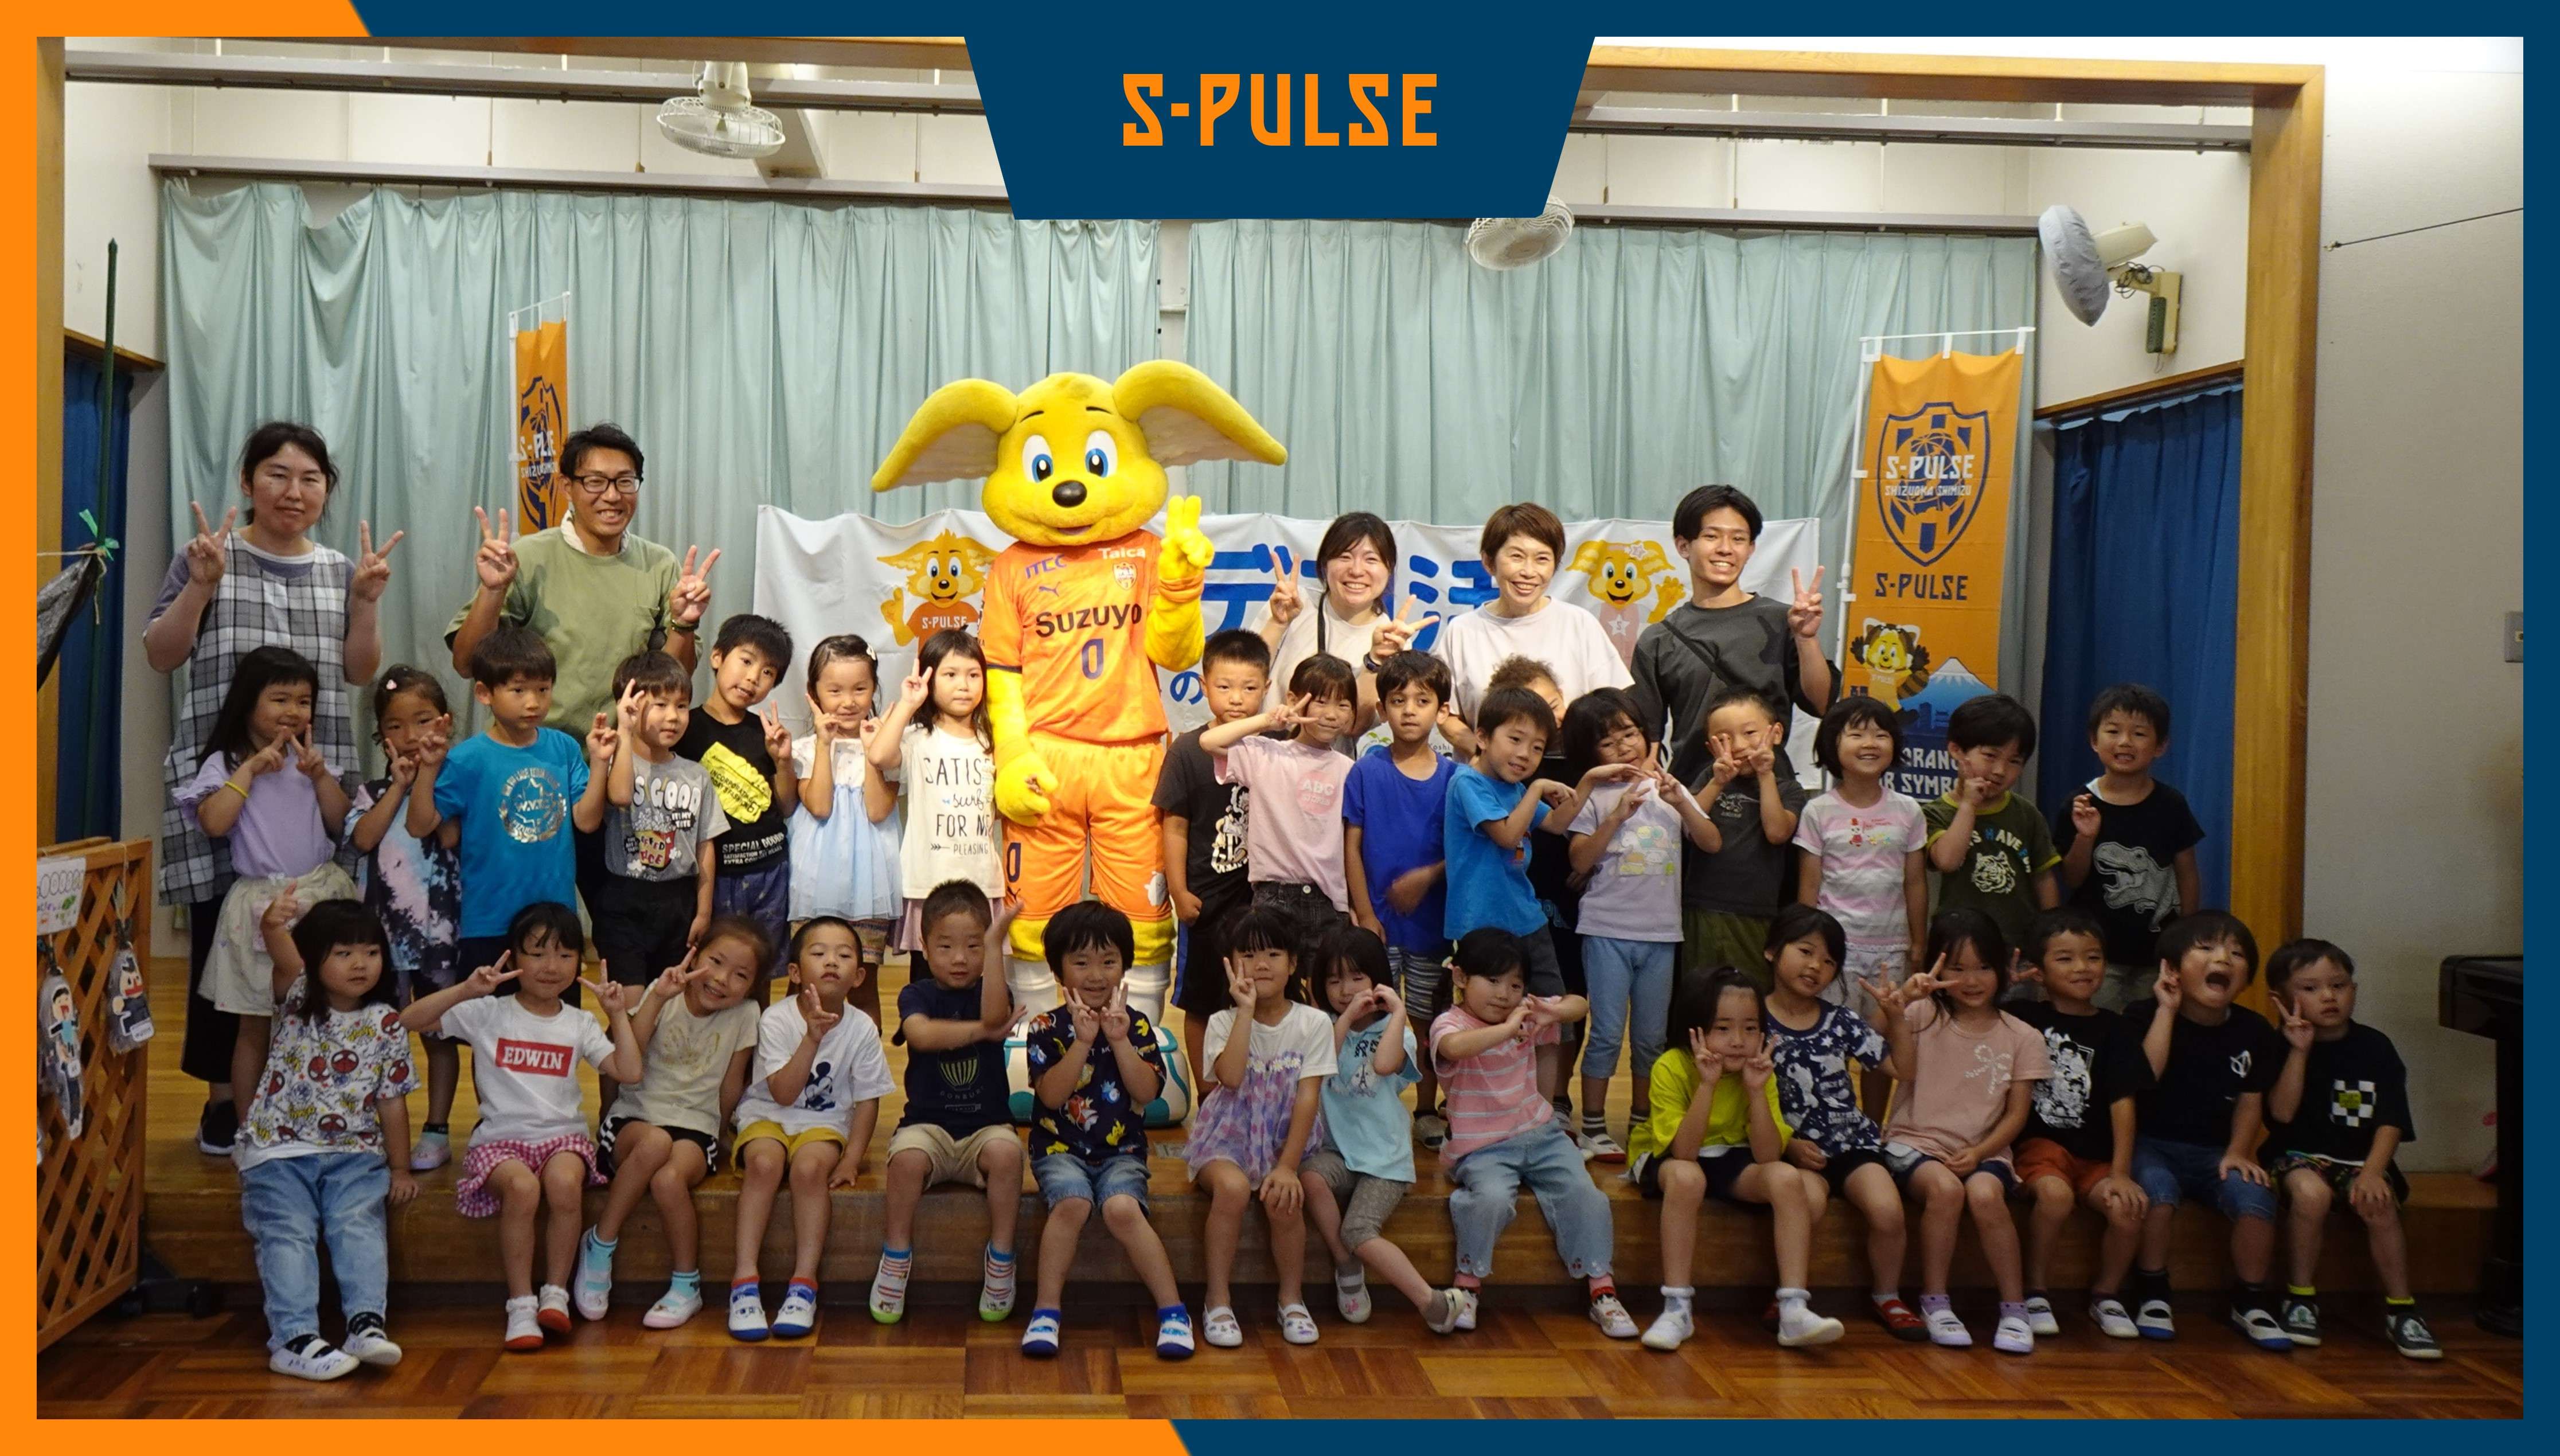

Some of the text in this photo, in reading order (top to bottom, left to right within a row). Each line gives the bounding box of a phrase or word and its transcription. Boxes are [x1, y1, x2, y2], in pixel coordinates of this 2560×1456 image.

[1886, 454, 1975, 479] S-PULSE
[1884, 485, 1973, 496] SHIZUOKA SHIMIZU
[1025, 553, 1067, 579] ITEC
[1874, 572, 1969, 601] S-PULSE
[922, 615, 969, 629] S-PULSE
[1035, 603, 1142, 638] Suzuyo
[1081, 637, 1105, 680] 0
[923, 757, 991, 786] SATIS
[1879, 771, 1895, 792] R
[650, 777, 702, 815] GOOD
[936, 814, 967, 837] FOR
[722, 840, 760, 853] SPECIAL
[953, 843, 989, 854] PLEASING
[1984, 829, 2023, 851] HAVE
[502, 1045, 565, 1070] EDWIN
